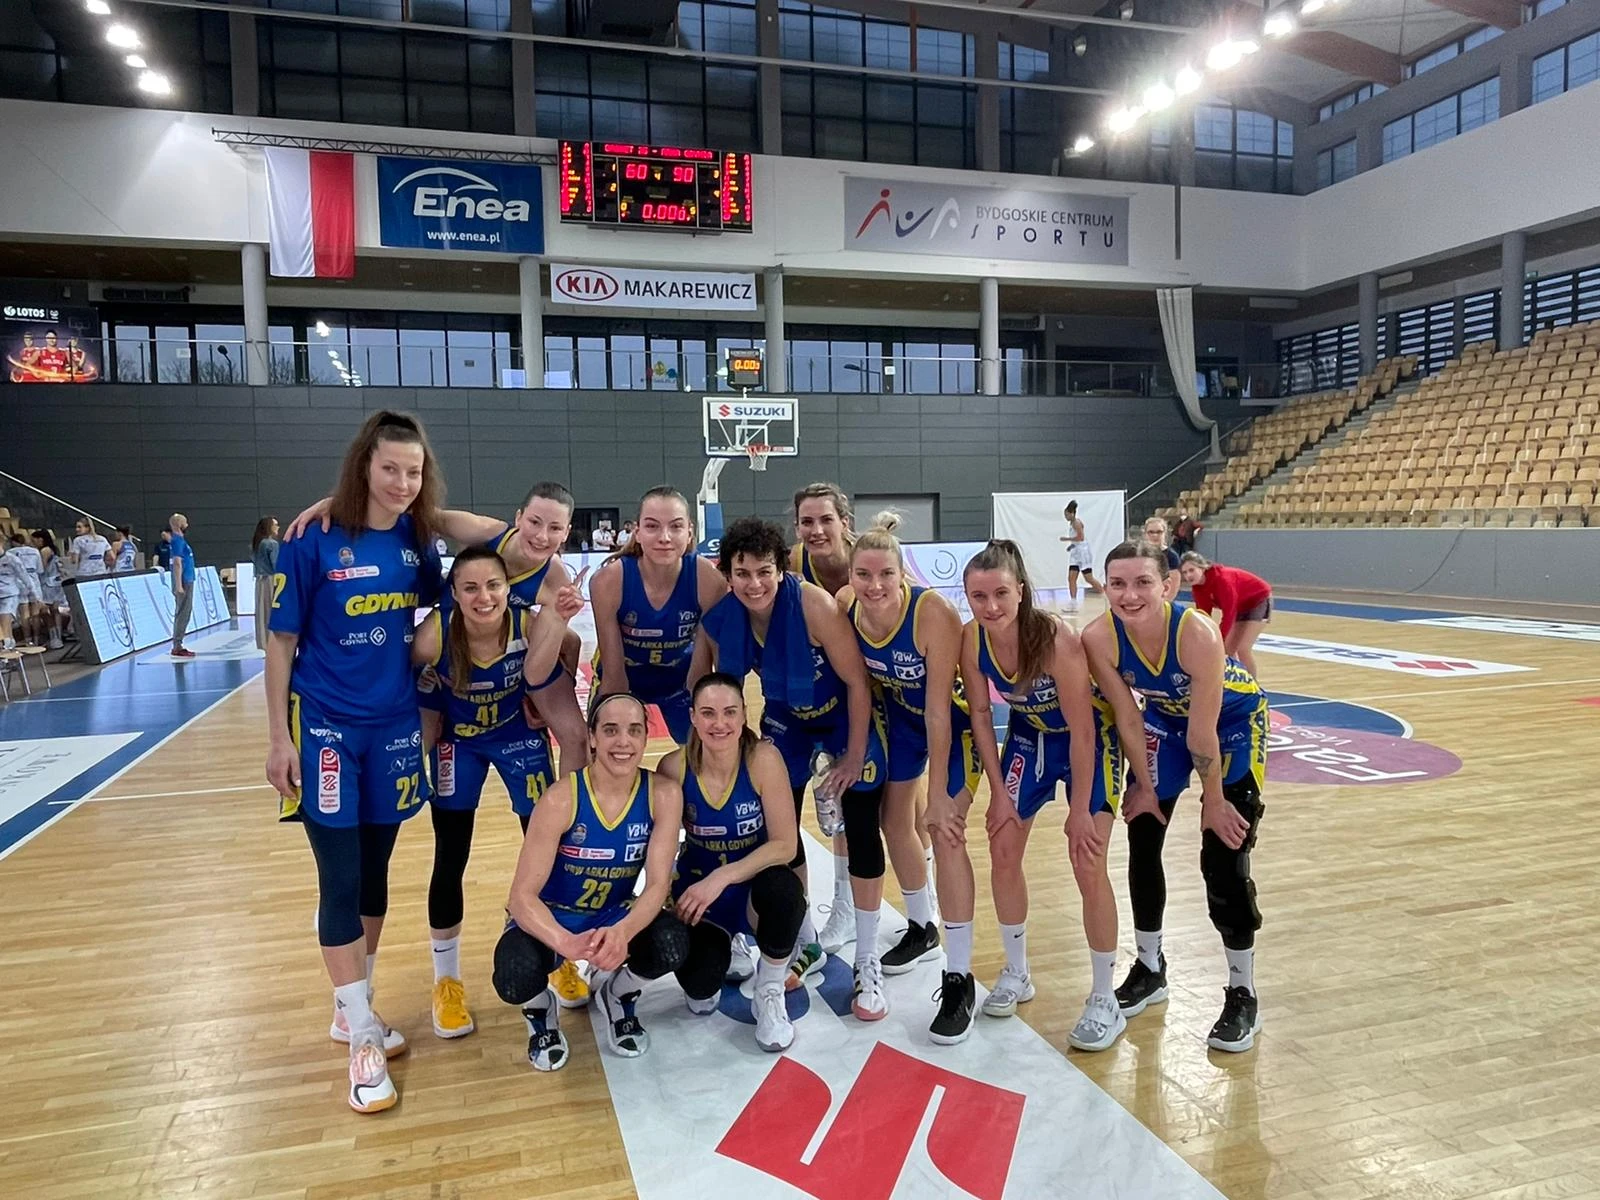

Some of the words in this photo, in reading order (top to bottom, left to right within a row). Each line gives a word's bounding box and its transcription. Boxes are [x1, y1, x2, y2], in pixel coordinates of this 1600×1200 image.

[625, 163, 648, 180] 60
[673, 166, 694, 183] 90
[413, 186, 530, 222] Enea
[975, 204, 1048, 224] BYDGOSKIE
[1051, 210, 1115, 228] CENTRUM
[426, 229, 501, 244] www.enea.pl
[566, 275, 609, 296] KIA
[623, 278, 753, 301] MAKAREWICZ
[16, 306, 45, 318] LOTOS
[734, 406, 785, 417] SUZUKI
[345, 592, 419, 617] GDYNIA
[649, 650, 662, 664] 5
[892, 650, 916, 662] VBW
[895, 665, 923, 678] P&P
[476, 703, 499, 727] 41
[396, 772, 421, 810] 22
[526, 771, 548, 804] 41
[575, 879, 612, 909] 23
